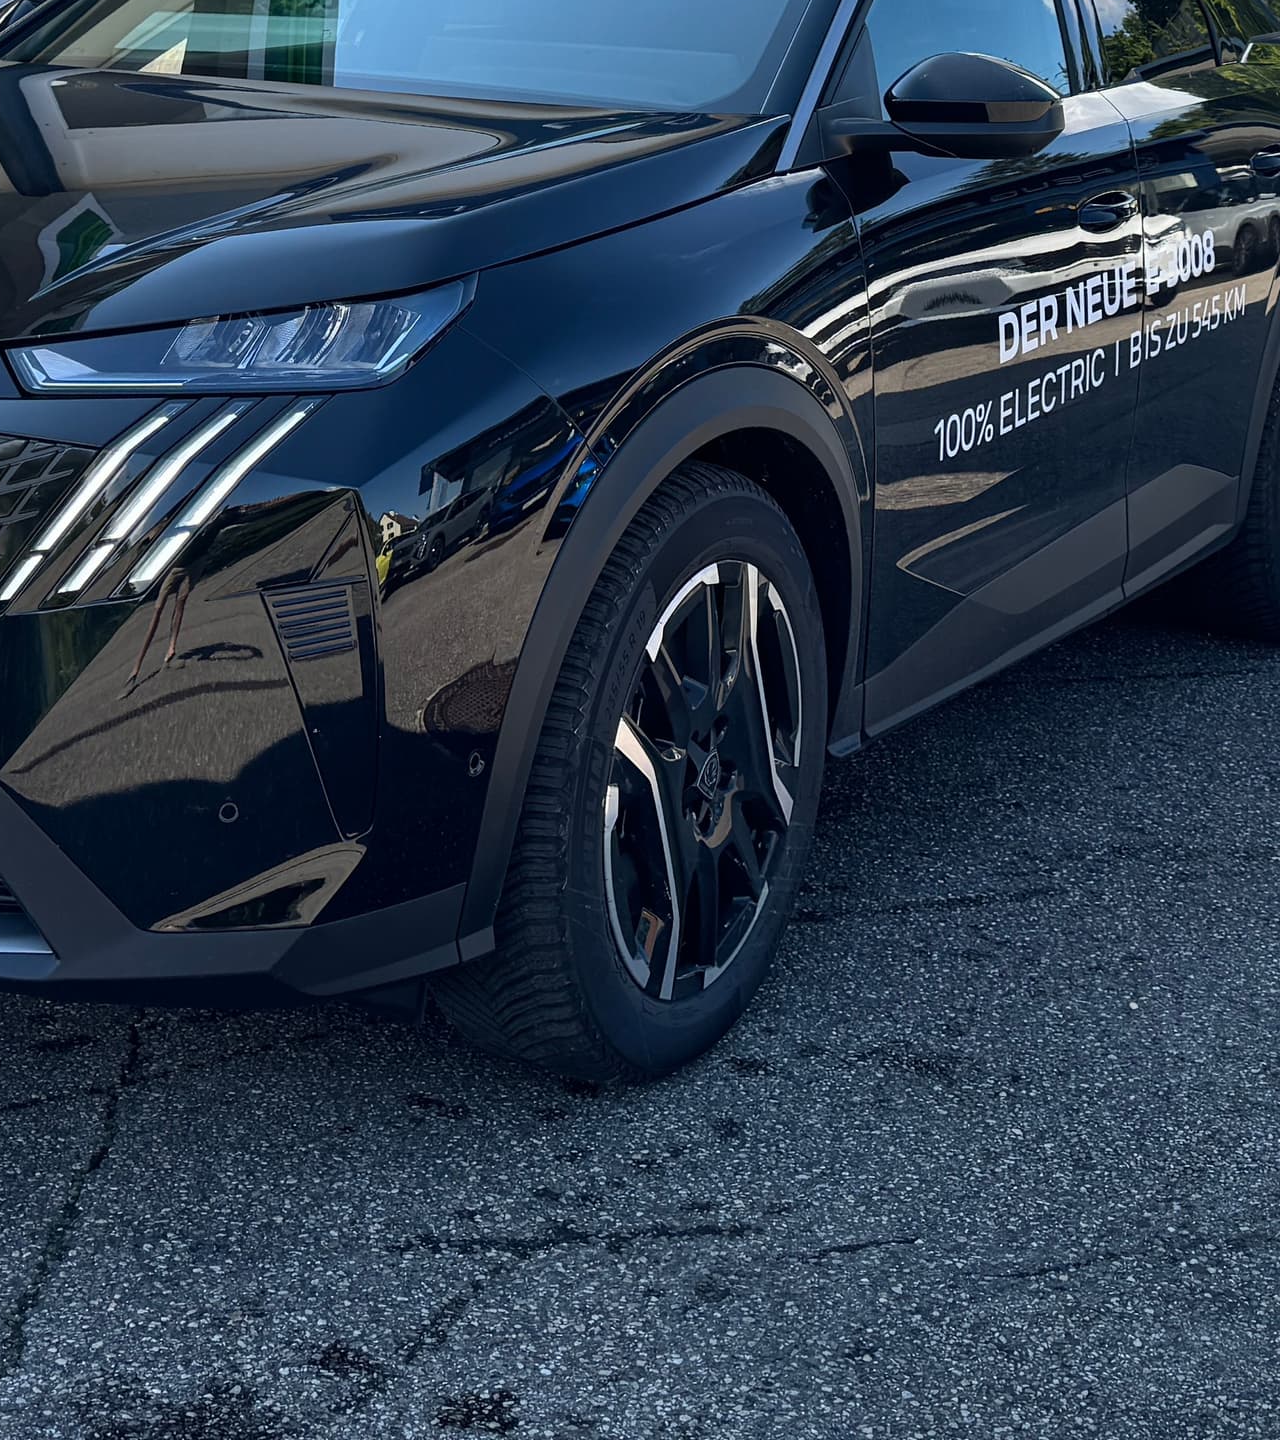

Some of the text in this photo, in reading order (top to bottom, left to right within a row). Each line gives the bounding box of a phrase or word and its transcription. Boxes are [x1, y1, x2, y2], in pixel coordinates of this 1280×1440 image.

[934, 399, 995, 462] 100%
[999, 348, 1105, 436] ELECTRIC
[1130, 320, 1162, 370] BIS
[1165, 307, 1189, 352] ZU
[1192, 295, 1220, 340] 545
[1223, 283, 1247, 326] KM
[998, 296, 1058, 364] DER
[1065, 261, 1136, 334] NEUE
